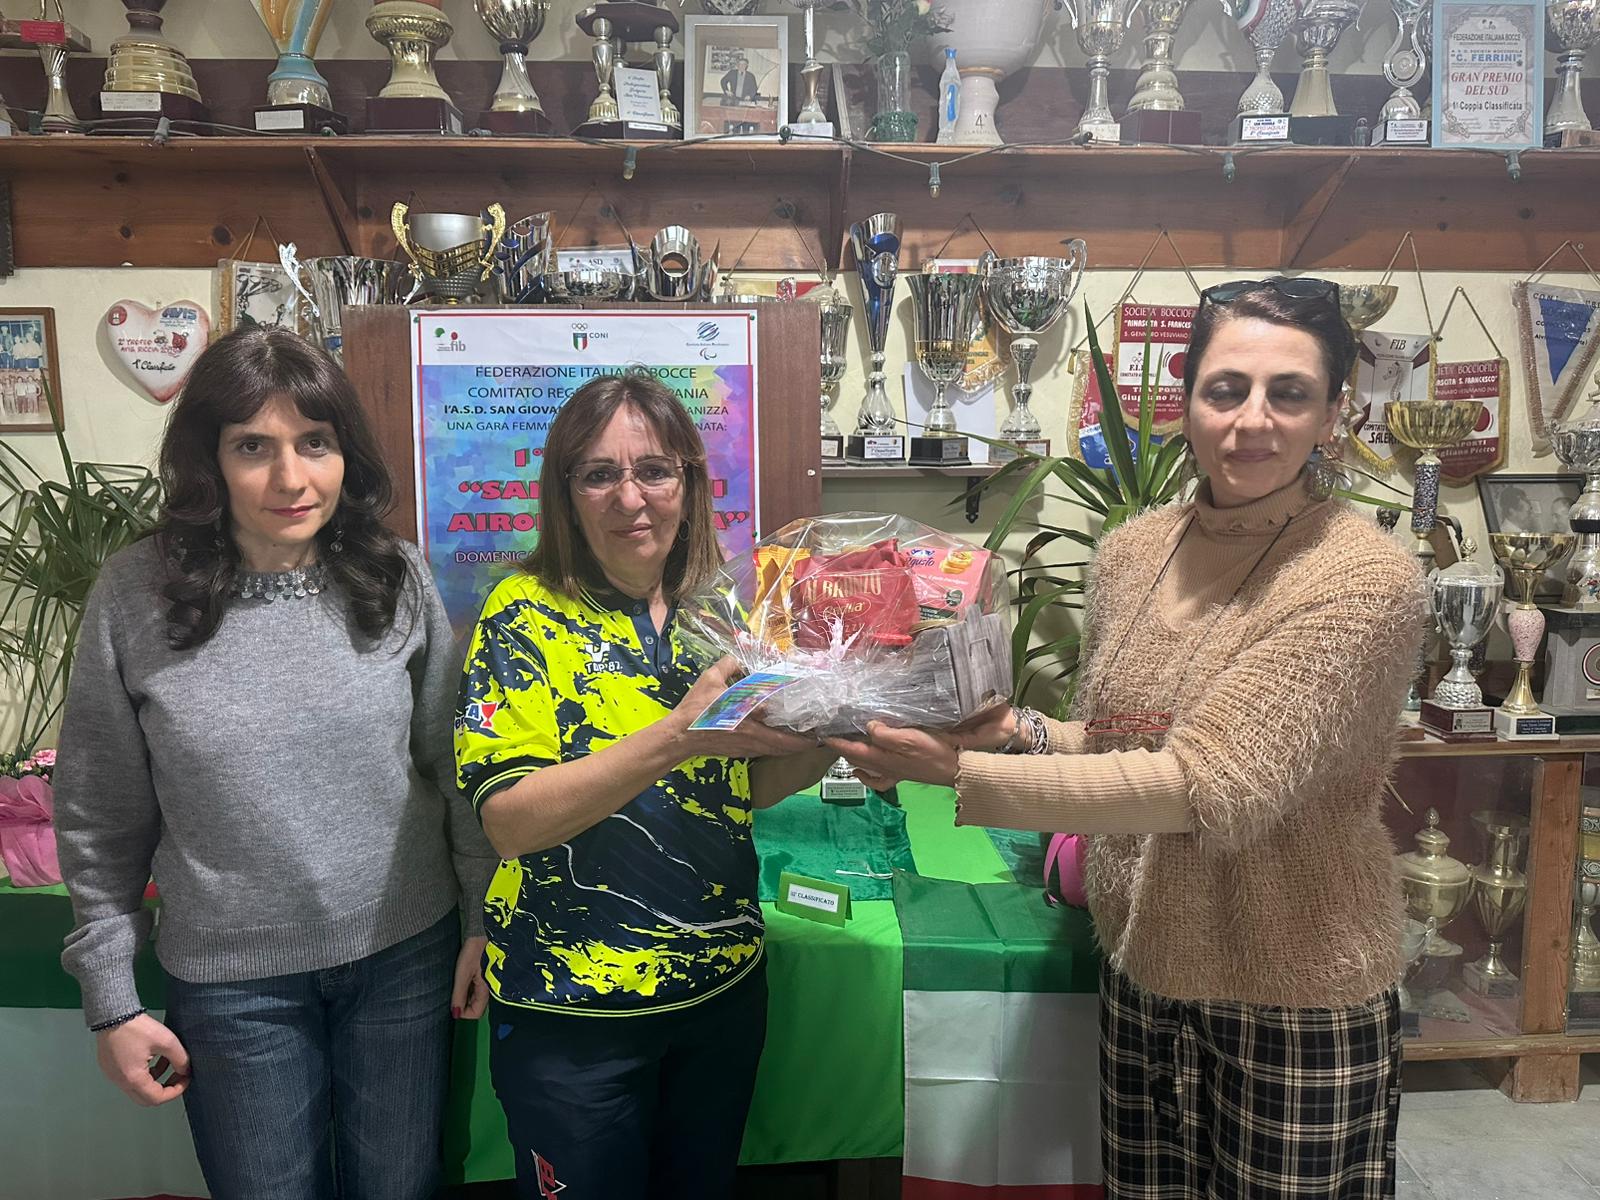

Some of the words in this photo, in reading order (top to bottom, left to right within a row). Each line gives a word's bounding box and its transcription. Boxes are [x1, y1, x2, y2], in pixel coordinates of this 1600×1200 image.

[1453, 33, 1484, 41] FEDERAZIONE
[1485, 33, 1505, 41] ITALIANA
[1505, 33, 1521, 41] BOCCE
[1451, 71, 1480, 82] GRAN
[1482, 71, 1523, 82] PREMIO
[1465, 85, 1486, 95] DEL
[1487, 85, 1509, 95] SUD
[1460, 101, 1482, 112] Coppia
[1484, 101, 1523, 110] Classificata
[162, 307, 197, 320] AVIS
[1160, 308, 1196, 318] BOCCIOF
[1124, 319, 1158, 328] "RINASCTA
[1167, 320, 1193, 329] FRANCES
[1390, 339, 1407, 351] FIB
[475, 366, 576, 378] FEDERAZIONE
[651, 367, 697, 379] BOCCE
[468, 387, 543, 399] COMITATO
[491, 405, 515, 415] SAN
[518, 405, 560, 415] GIOVA
[687, 406, 729, 415] ANIZZA
[447, 421, 473, 431] UNA
[476, 421, 509, 431] GARA
[1439, 448, 1469, 458] gliano
[1470, 446, 1496, 455] Pietro
[447, 511, 543, 532] AIRO
[455, 551, 532, 563] DOMENIC
[797, 892, 835, 906] CLASSIFICATO
